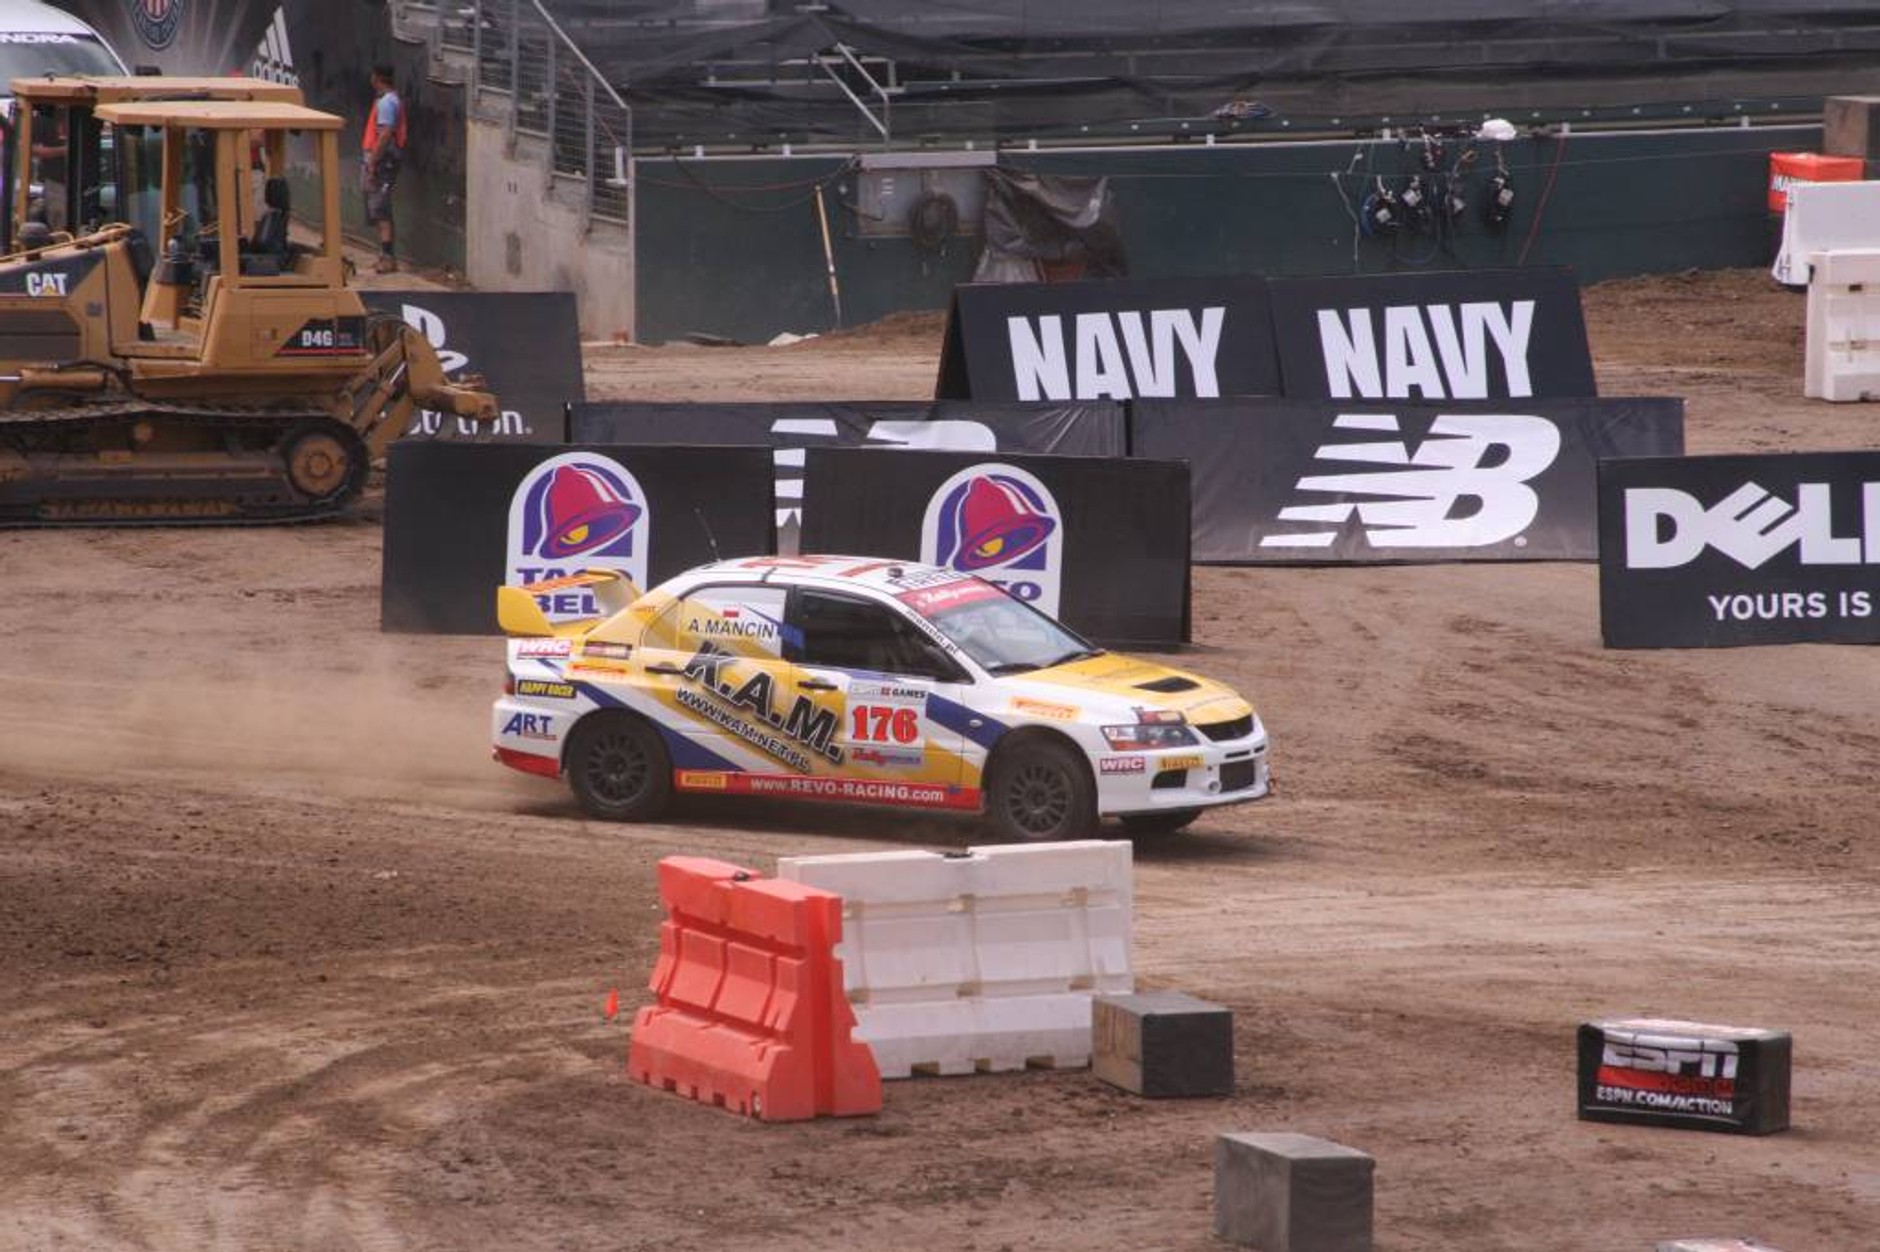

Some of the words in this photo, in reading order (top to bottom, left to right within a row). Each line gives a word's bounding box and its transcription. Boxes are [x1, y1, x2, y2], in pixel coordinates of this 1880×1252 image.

[26, 273, 67, 297] CAT
[301, 330, 334, 347] D4G
[1317, 300, 1536, 399] NAVY
[1007, 308, 1226, 401] NAVY
[1624, 481, 1880, 570] DEL
[1708, 592, 1828, 621] YOURS
[1839, 591, 1873, 617] IS
[683, 640, 844, 764] K.A.M.
[892, 687, 926, 699] GAMES
[501, 712, 553, 736] ART
[852, 705, 918, 744] 176
[1101, 758, 1143, 771] WRC
[1602, 1031, 1739, 1078] ESPN
[1597, 1087, 1733, 1115] ESPN.COM/ACTION
